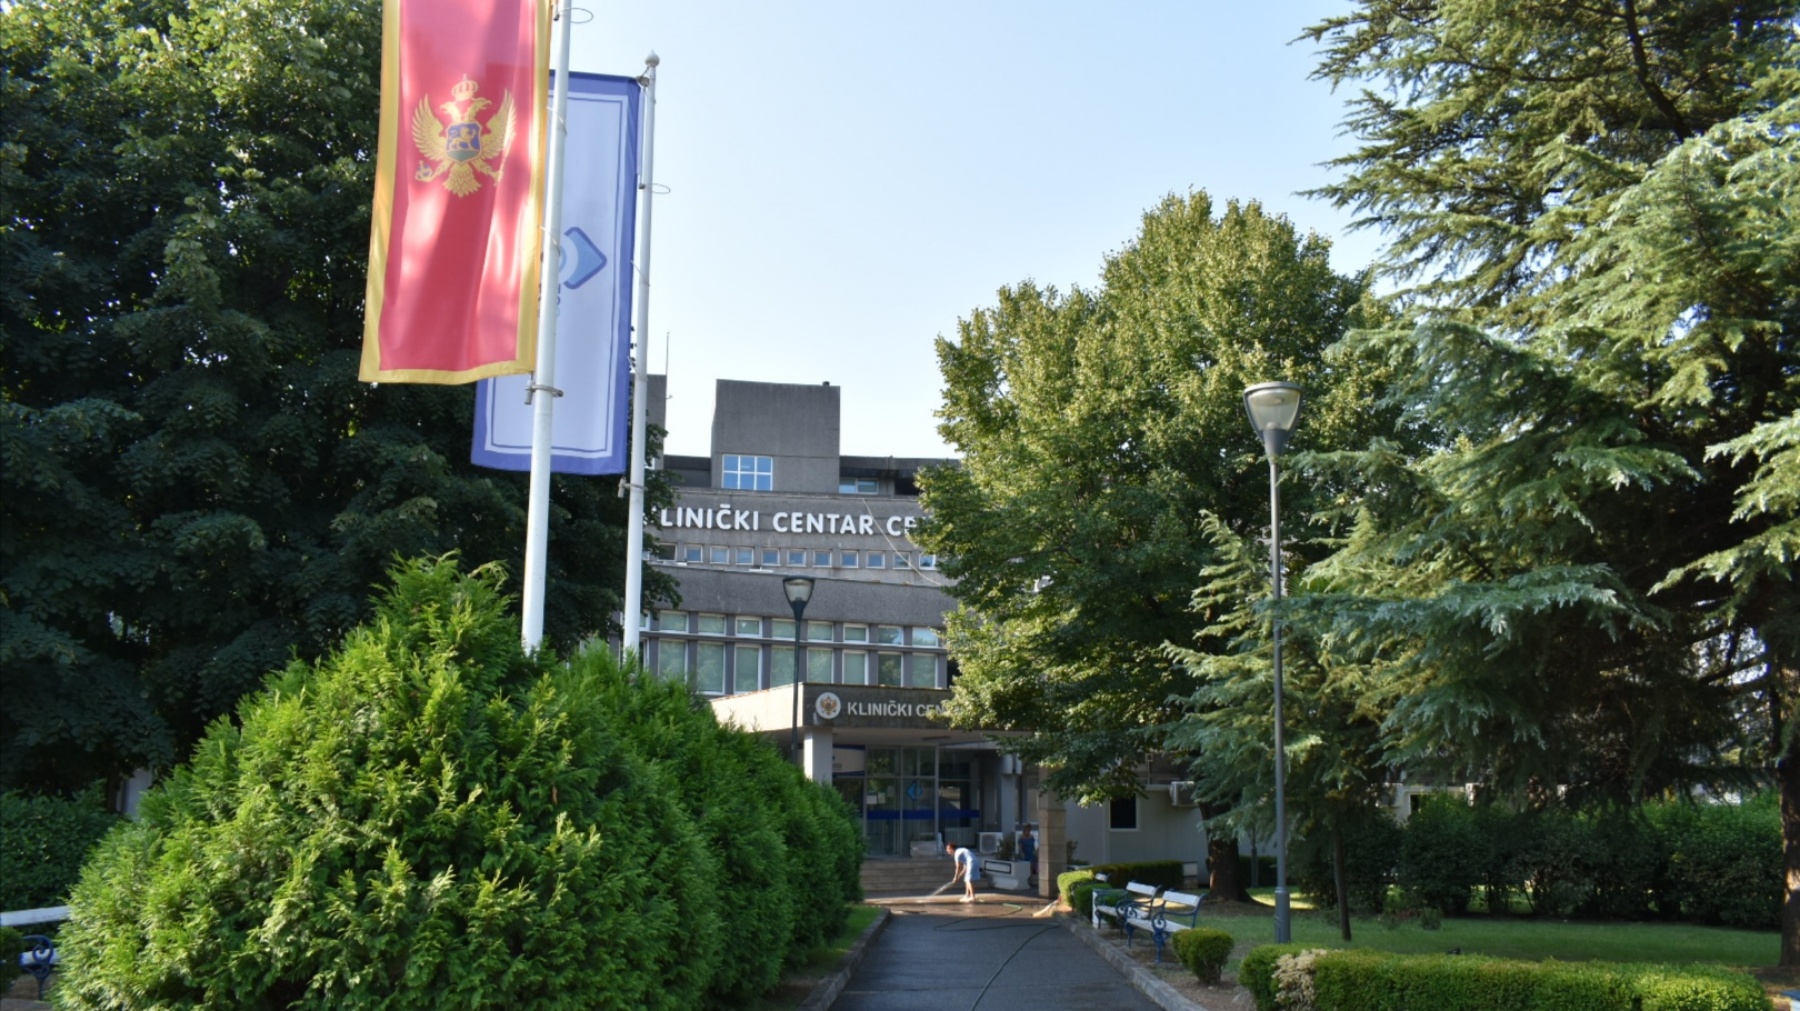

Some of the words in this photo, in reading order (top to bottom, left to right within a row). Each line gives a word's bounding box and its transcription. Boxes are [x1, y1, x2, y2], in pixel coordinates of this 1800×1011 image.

[643, 504, 759, 531] LINIČKI
[772, 511, 874, 535] CENTAR
[886, 515, 920, 537] CR
[847, 700, 912, 717] KLINIČKI
[916, 703, 946, 717] CEN
